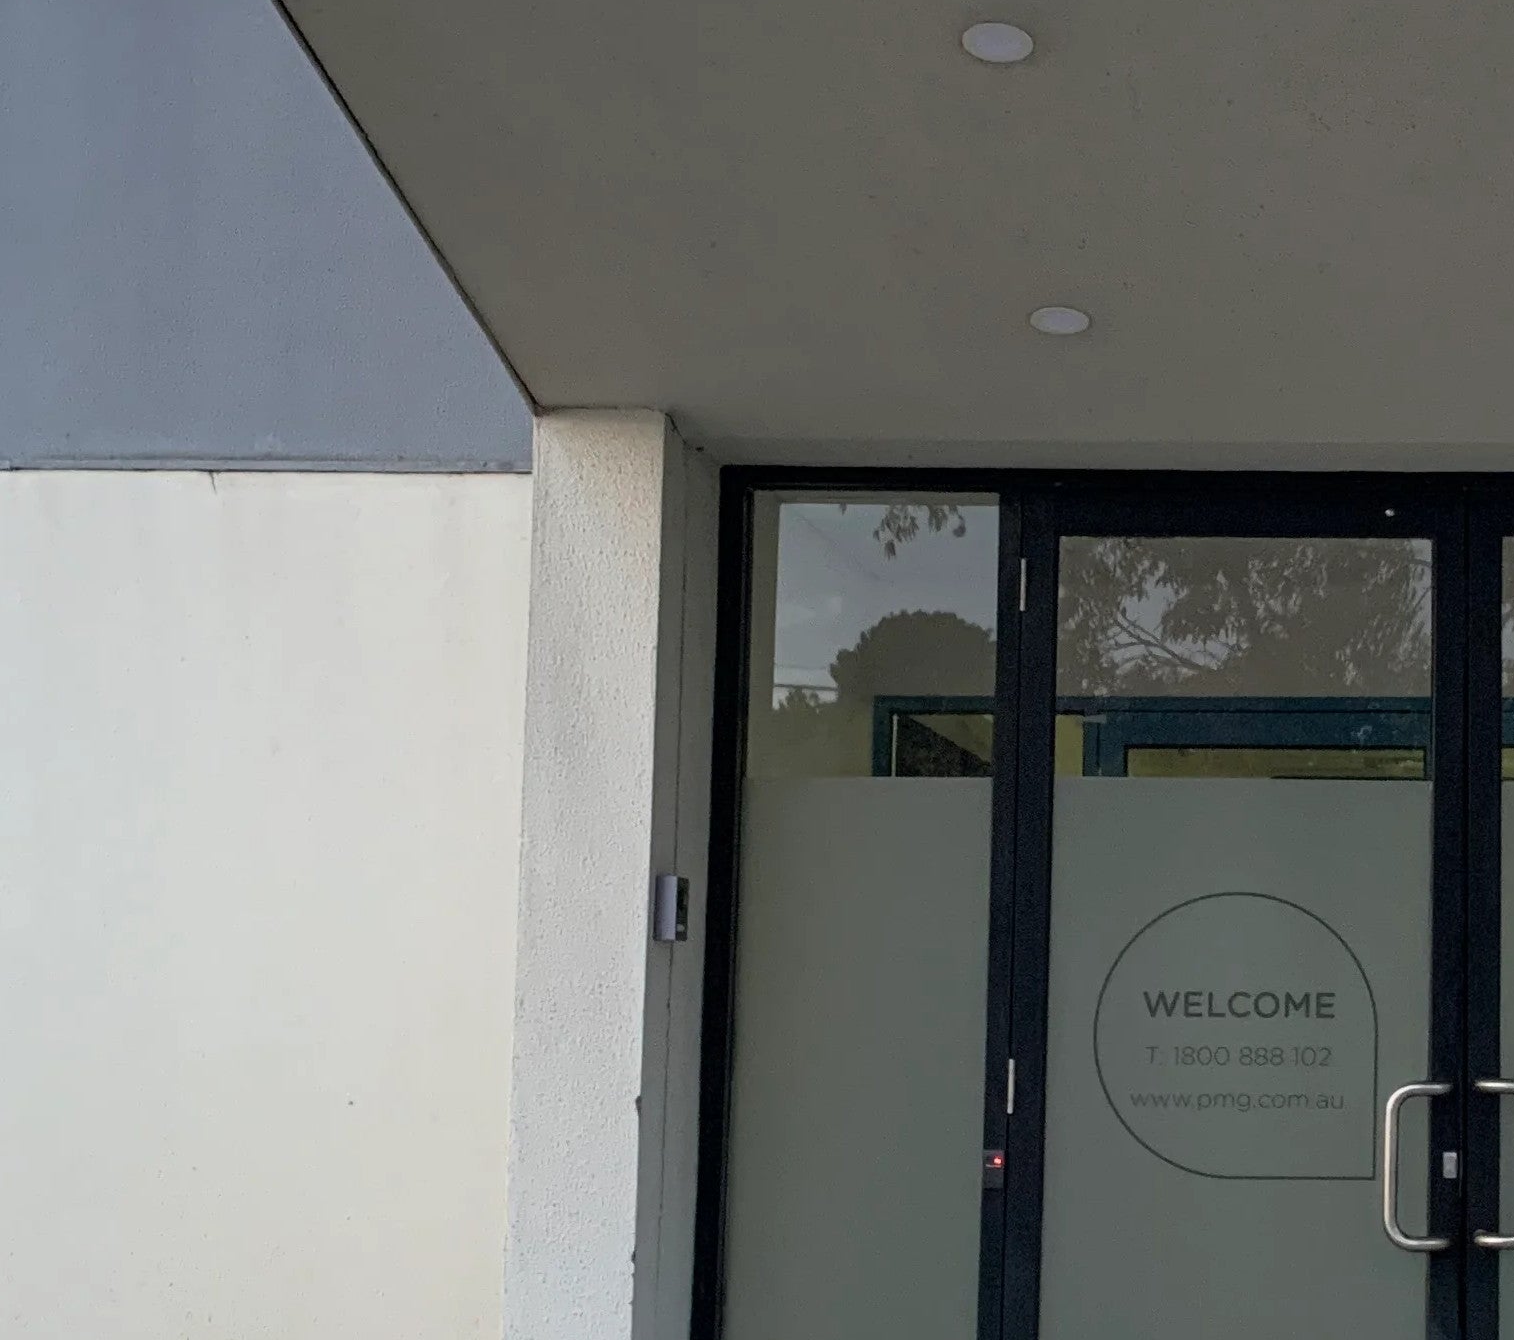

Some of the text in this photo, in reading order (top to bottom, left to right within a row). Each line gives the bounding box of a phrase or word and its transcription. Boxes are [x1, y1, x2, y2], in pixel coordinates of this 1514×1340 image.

[1143, 991, 1336, 1018] WELCOME
[1174, 1046, 1231, 1066] 1800
[1238, 1046, 1284, 1066] 888
[1293, 1046, 1332, 1067] 102
[1129, 1091, 1345, 1112] www.pmg.com.au
